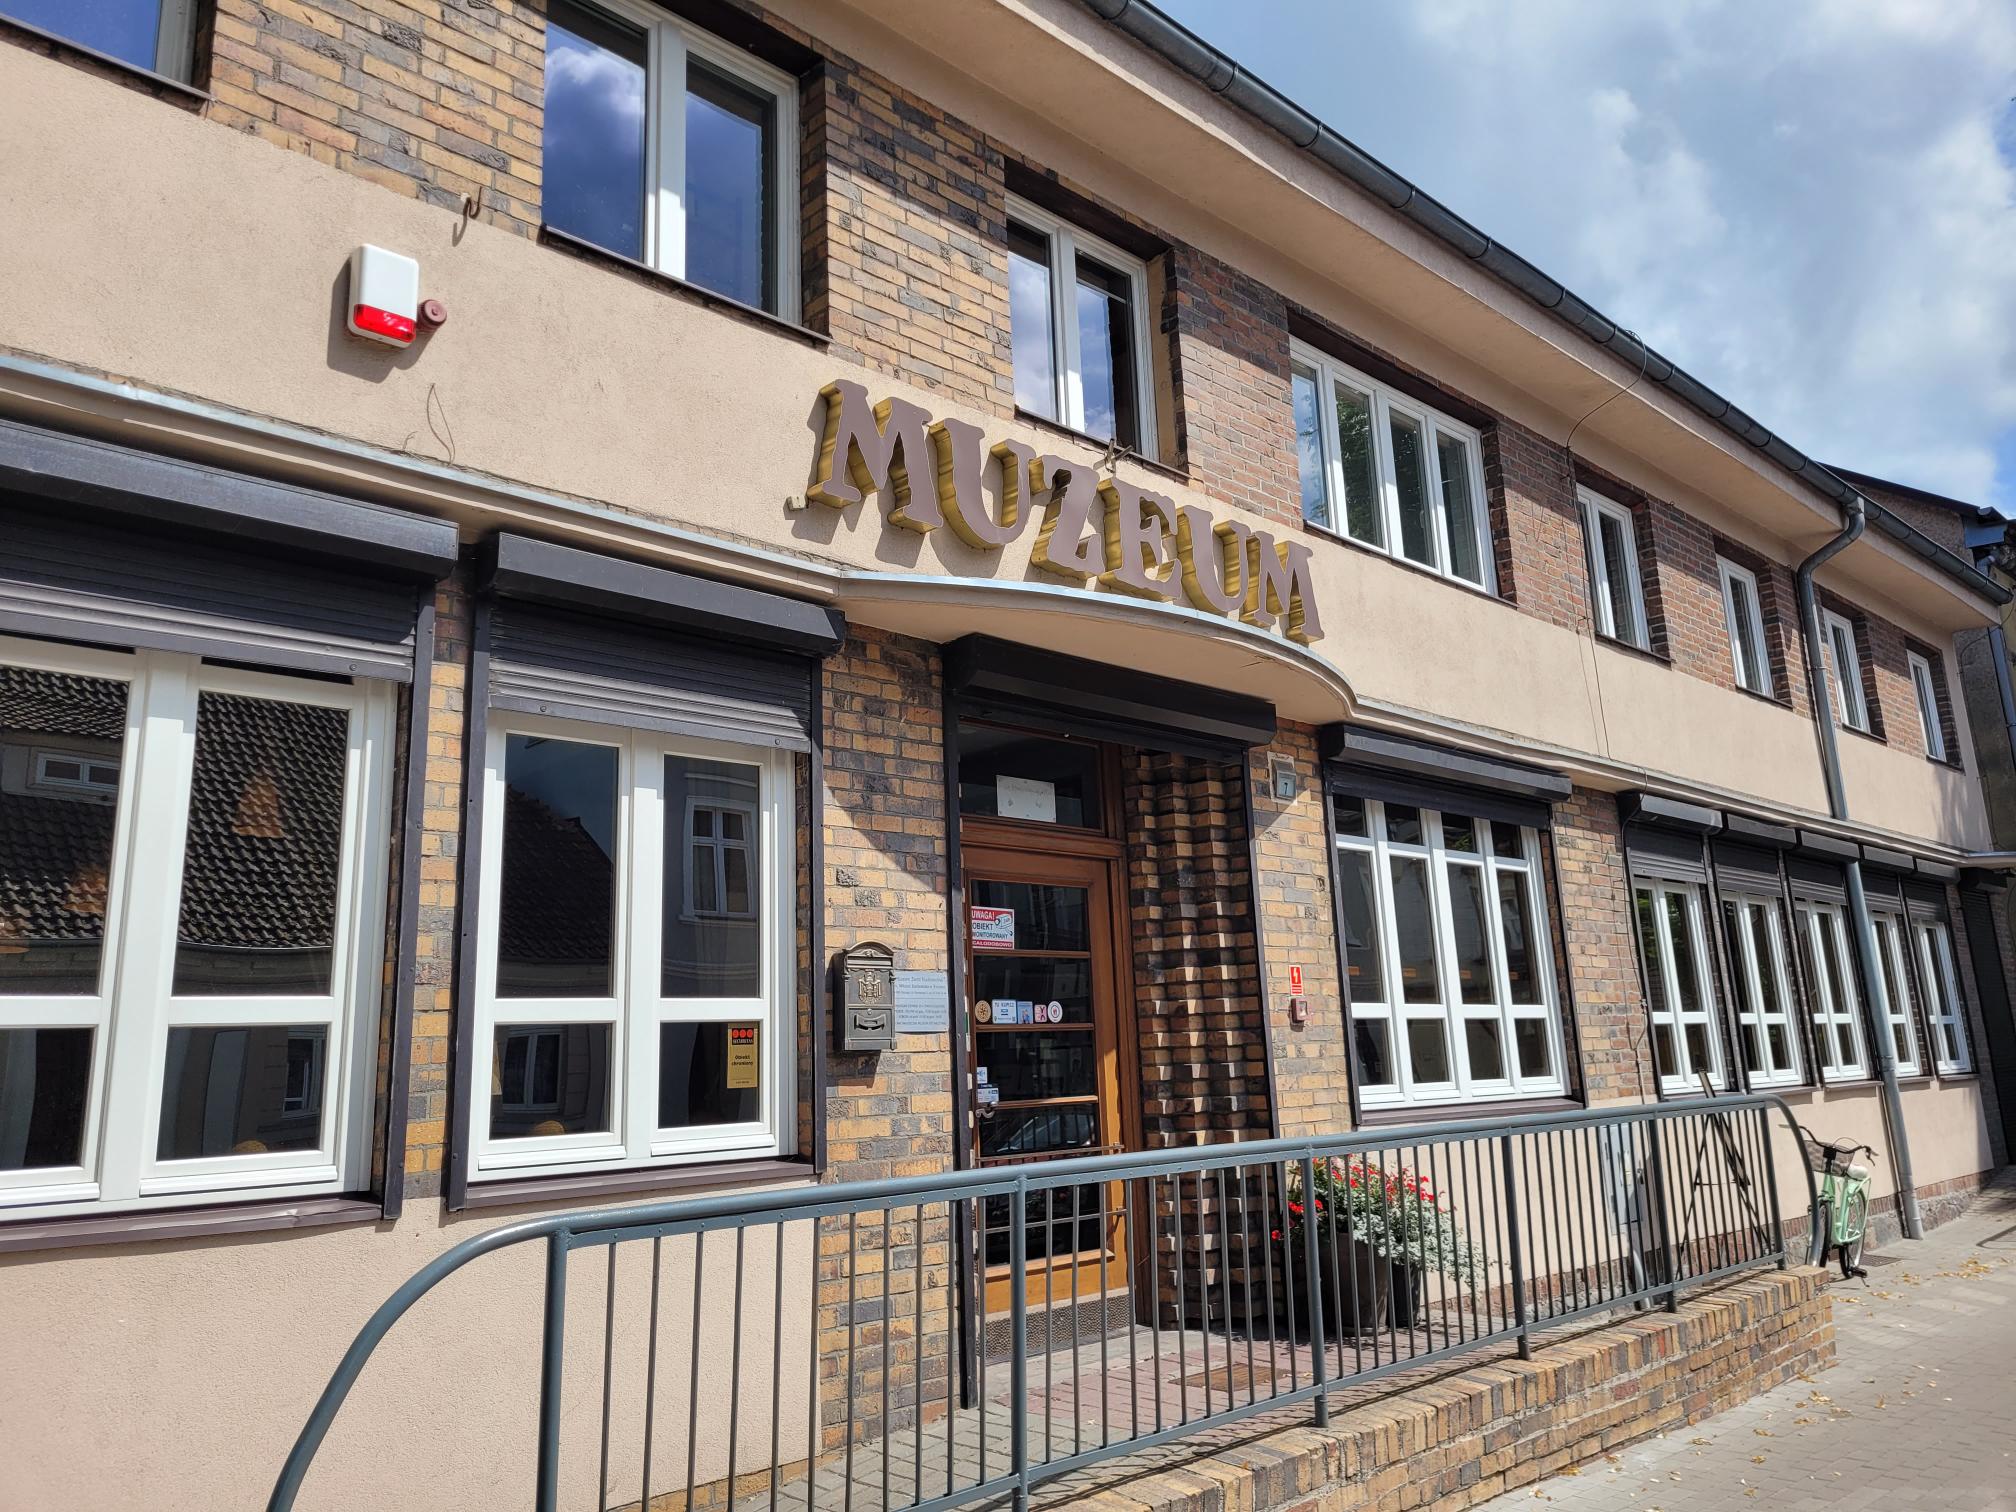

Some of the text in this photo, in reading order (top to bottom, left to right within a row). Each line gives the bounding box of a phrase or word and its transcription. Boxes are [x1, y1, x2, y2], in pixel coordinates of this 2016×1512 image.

[807, 379, 1324, 643] MUZEUM
[972, 910, 994, 919] UWAGA!
[972, 922, 994, 930] OBIEKT
